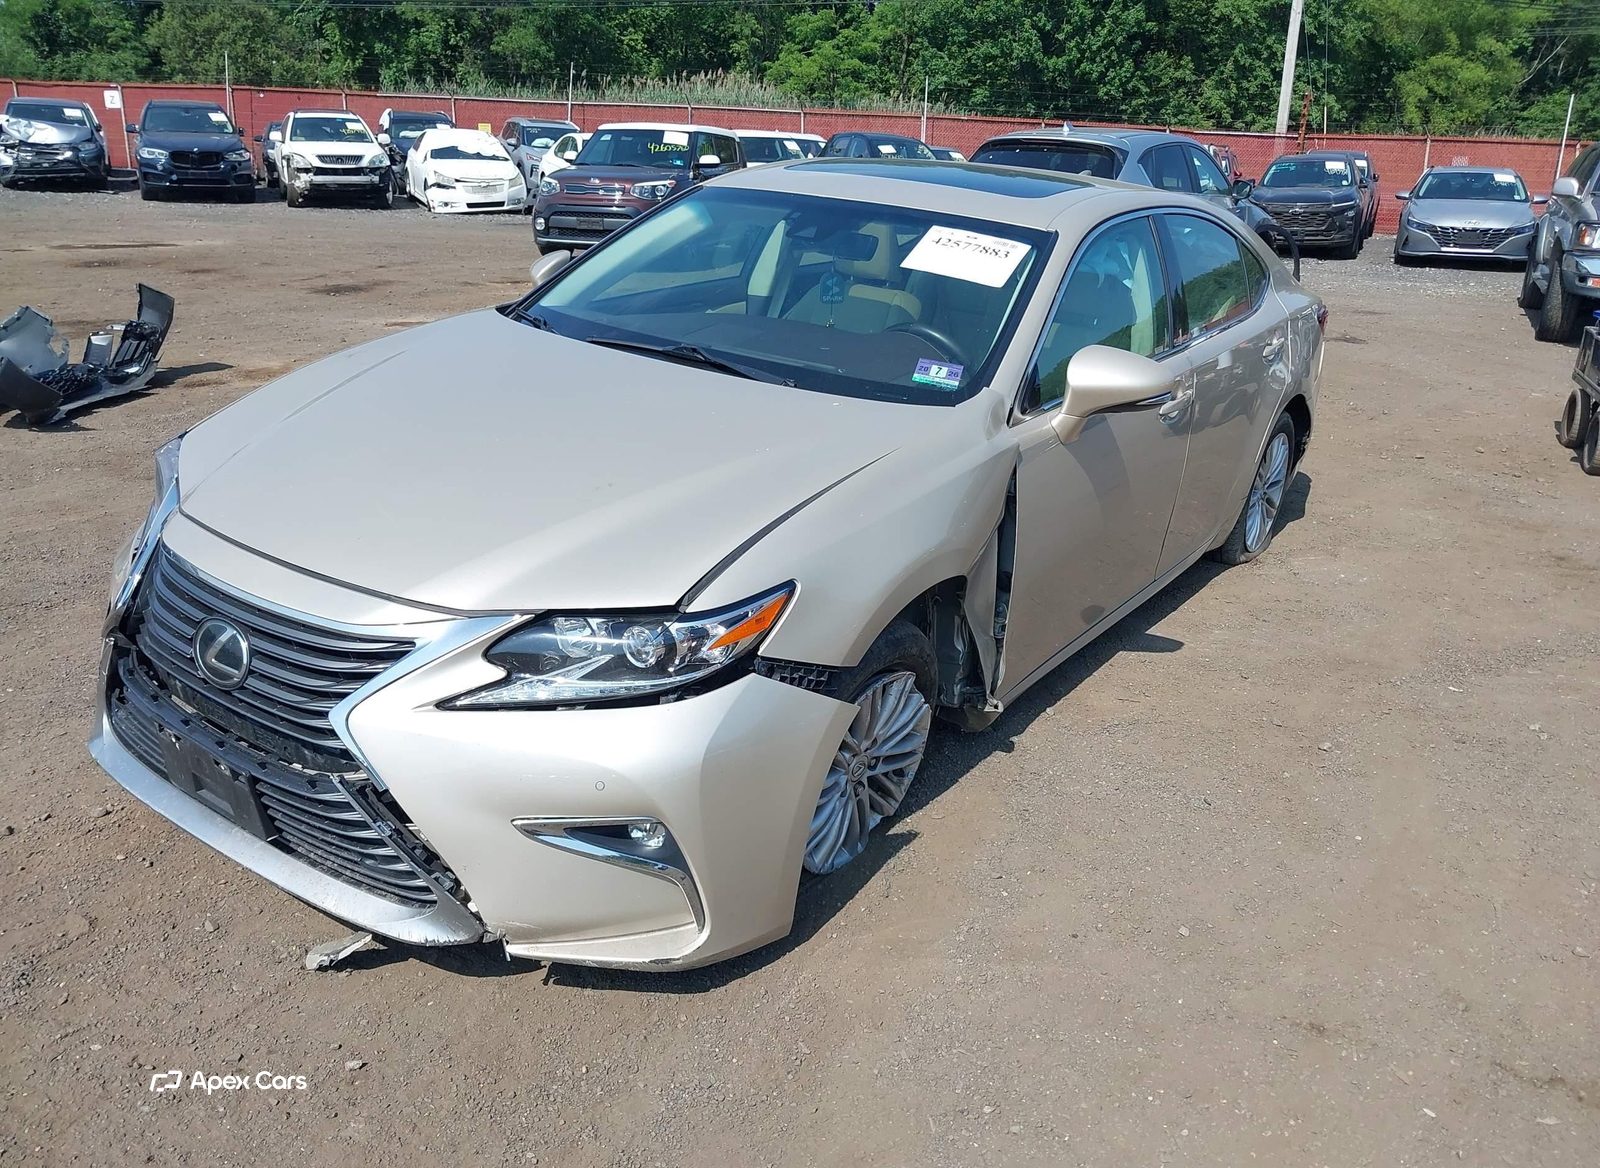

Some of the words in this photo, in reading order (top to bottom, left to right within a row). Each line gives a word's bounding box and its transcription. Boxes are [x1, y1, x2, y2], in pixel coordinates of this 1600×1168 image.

[109, 95, 116, 105] Z
[931, 237, 1011, 259] 42577883
[935, 366, 943, 376] 7
[947, 370, 959, 378] 26
